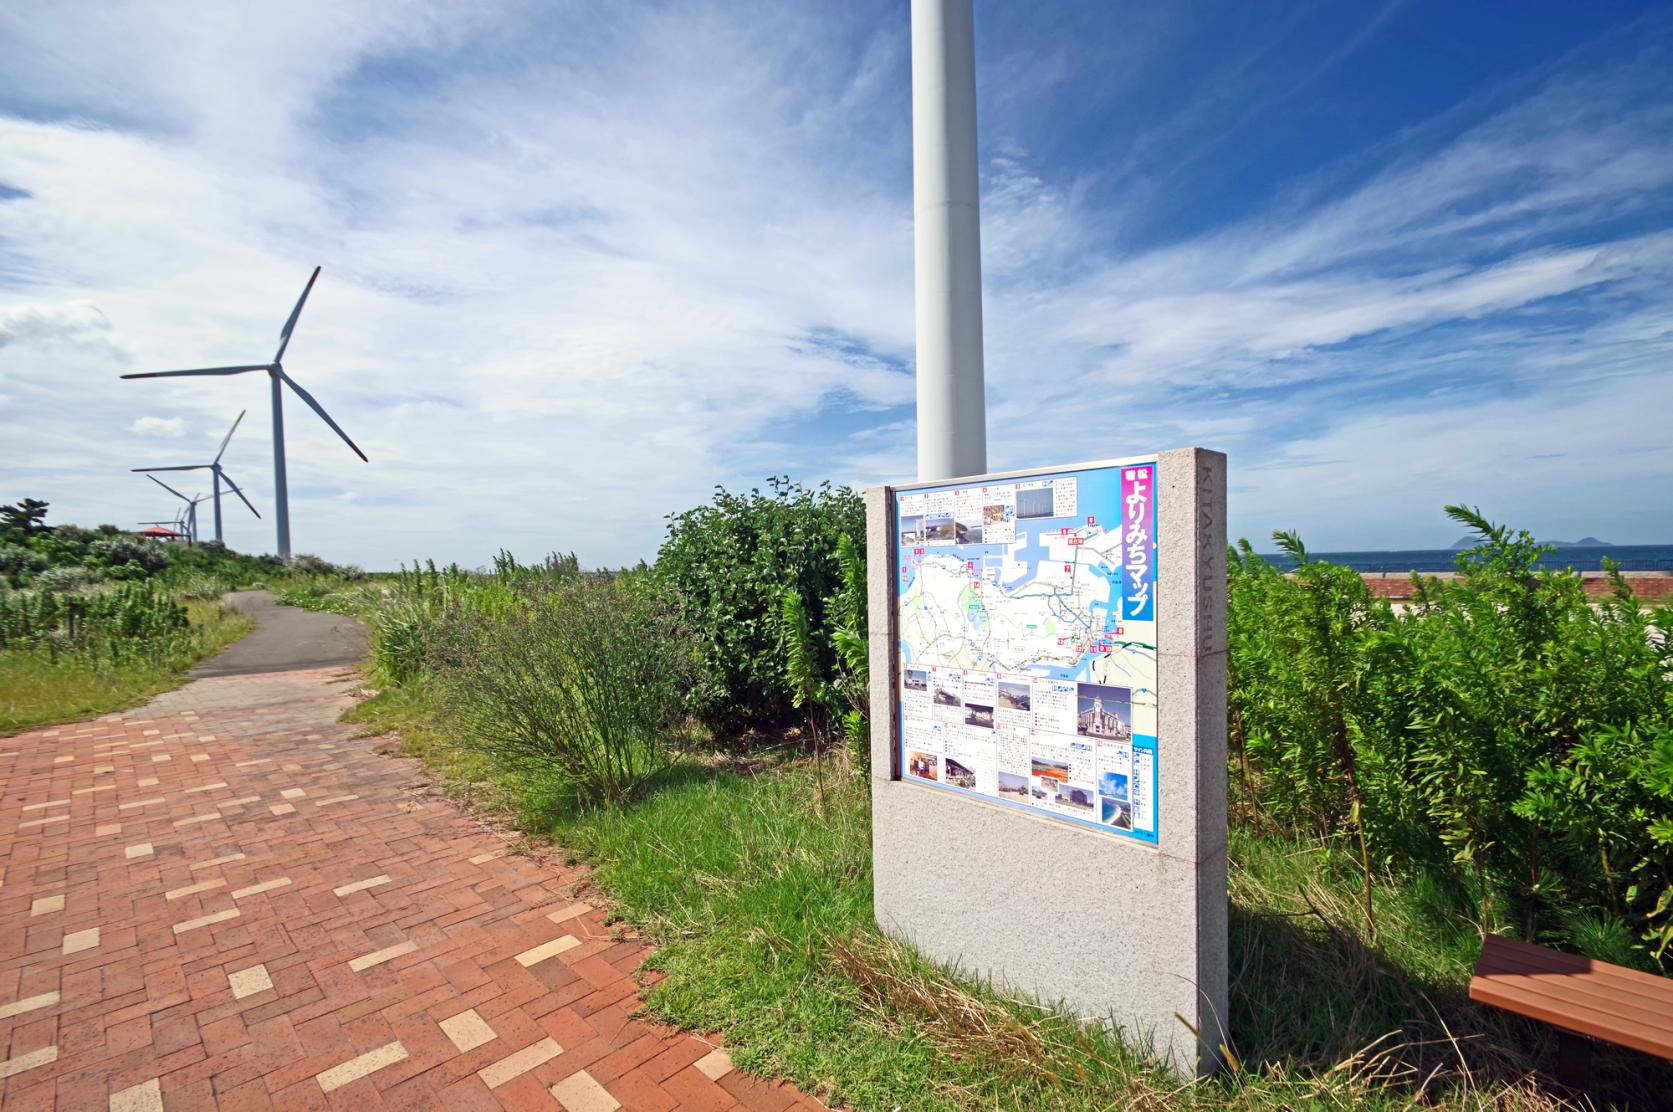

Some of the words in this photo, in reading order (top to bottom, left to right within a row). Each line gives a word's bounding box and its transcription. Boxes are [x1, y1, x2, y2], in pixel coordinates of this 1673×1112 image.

[1125, 481, 1150, 617] よりみちマップ
[1201, 466, 1213, 651] KITAKYUSHU
